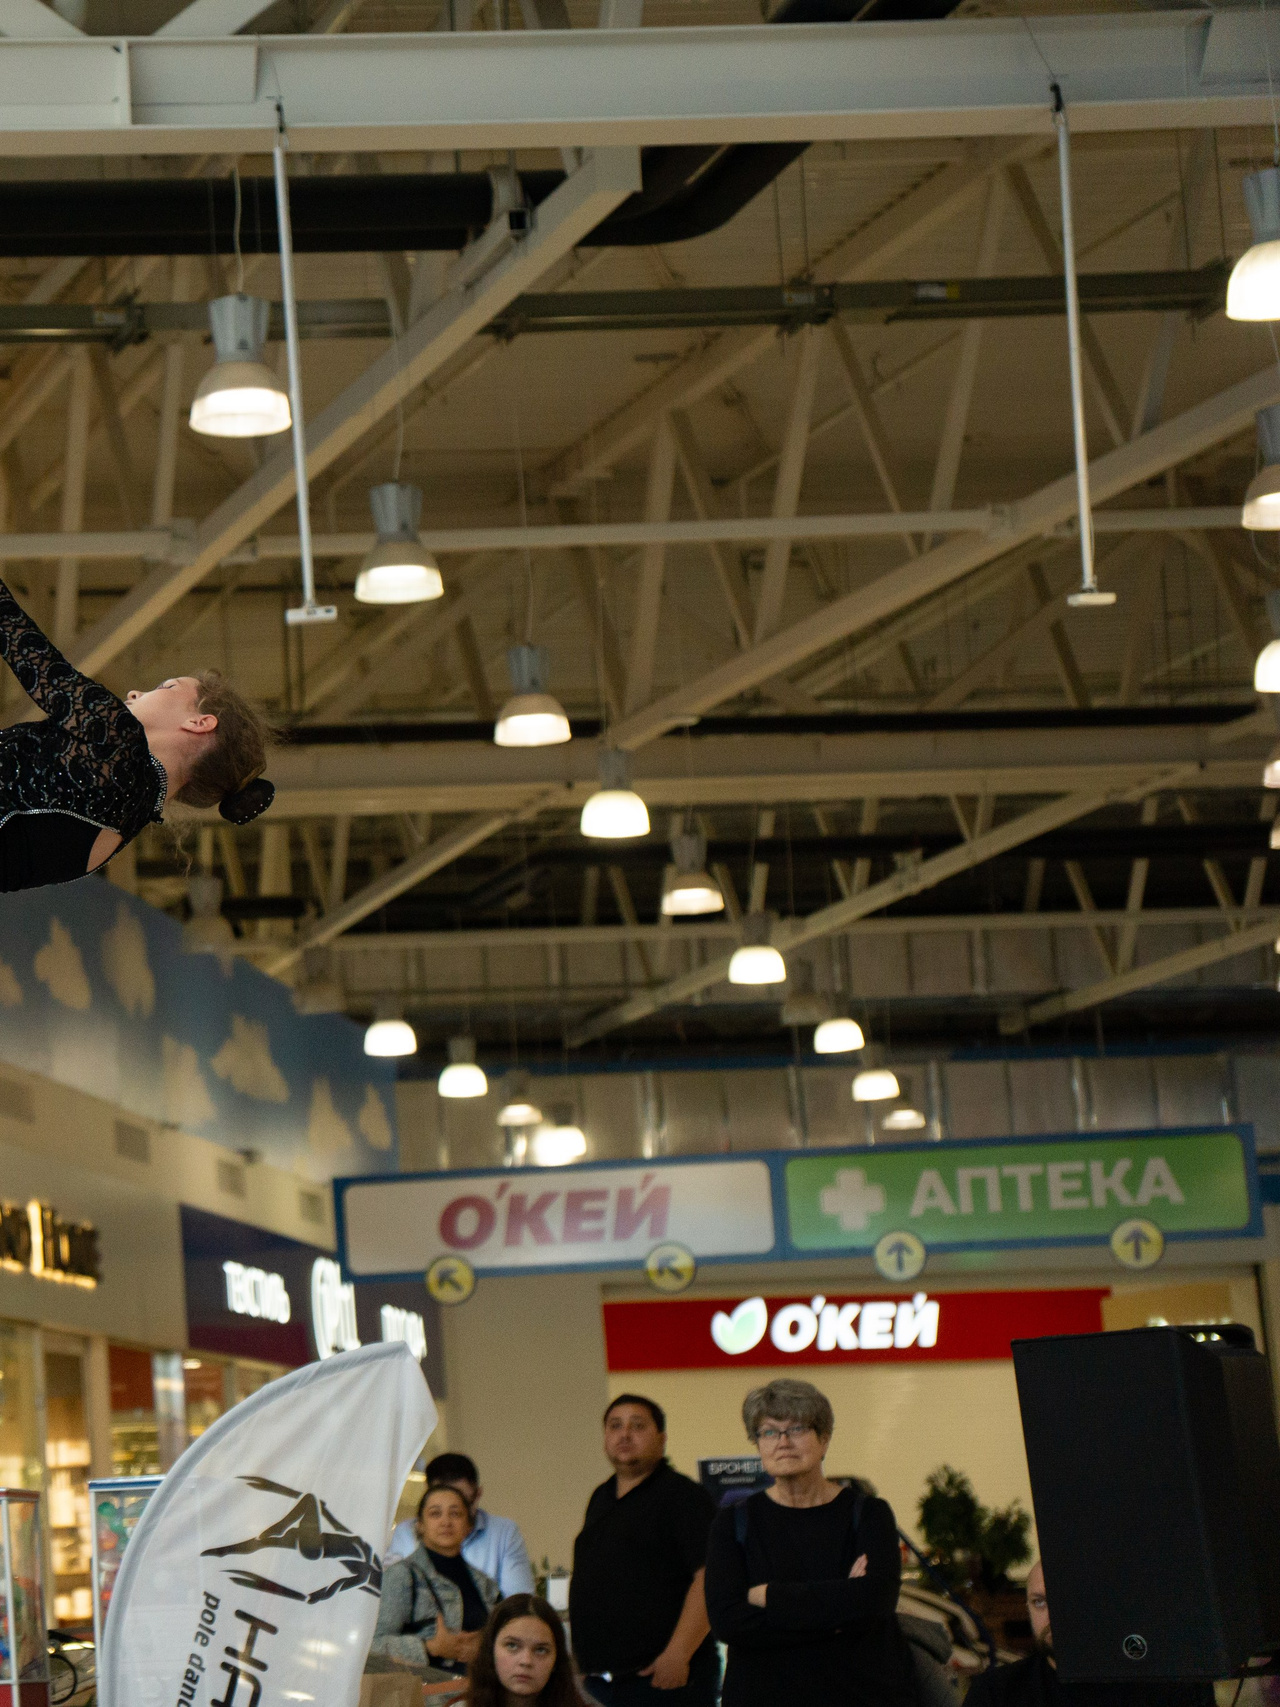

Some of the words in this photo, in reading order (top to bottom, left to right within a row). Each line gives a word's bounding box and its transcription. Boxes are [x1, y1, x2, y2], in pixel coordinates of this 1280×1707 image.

[439, 1171, 671, 1250] О'КЕЙ
[909, 1155, 1185, 1218] АПТЕКА
[771, 1291, 940, 1353] О'КЕЙ
[194, 1591, 221, 1647] pole
